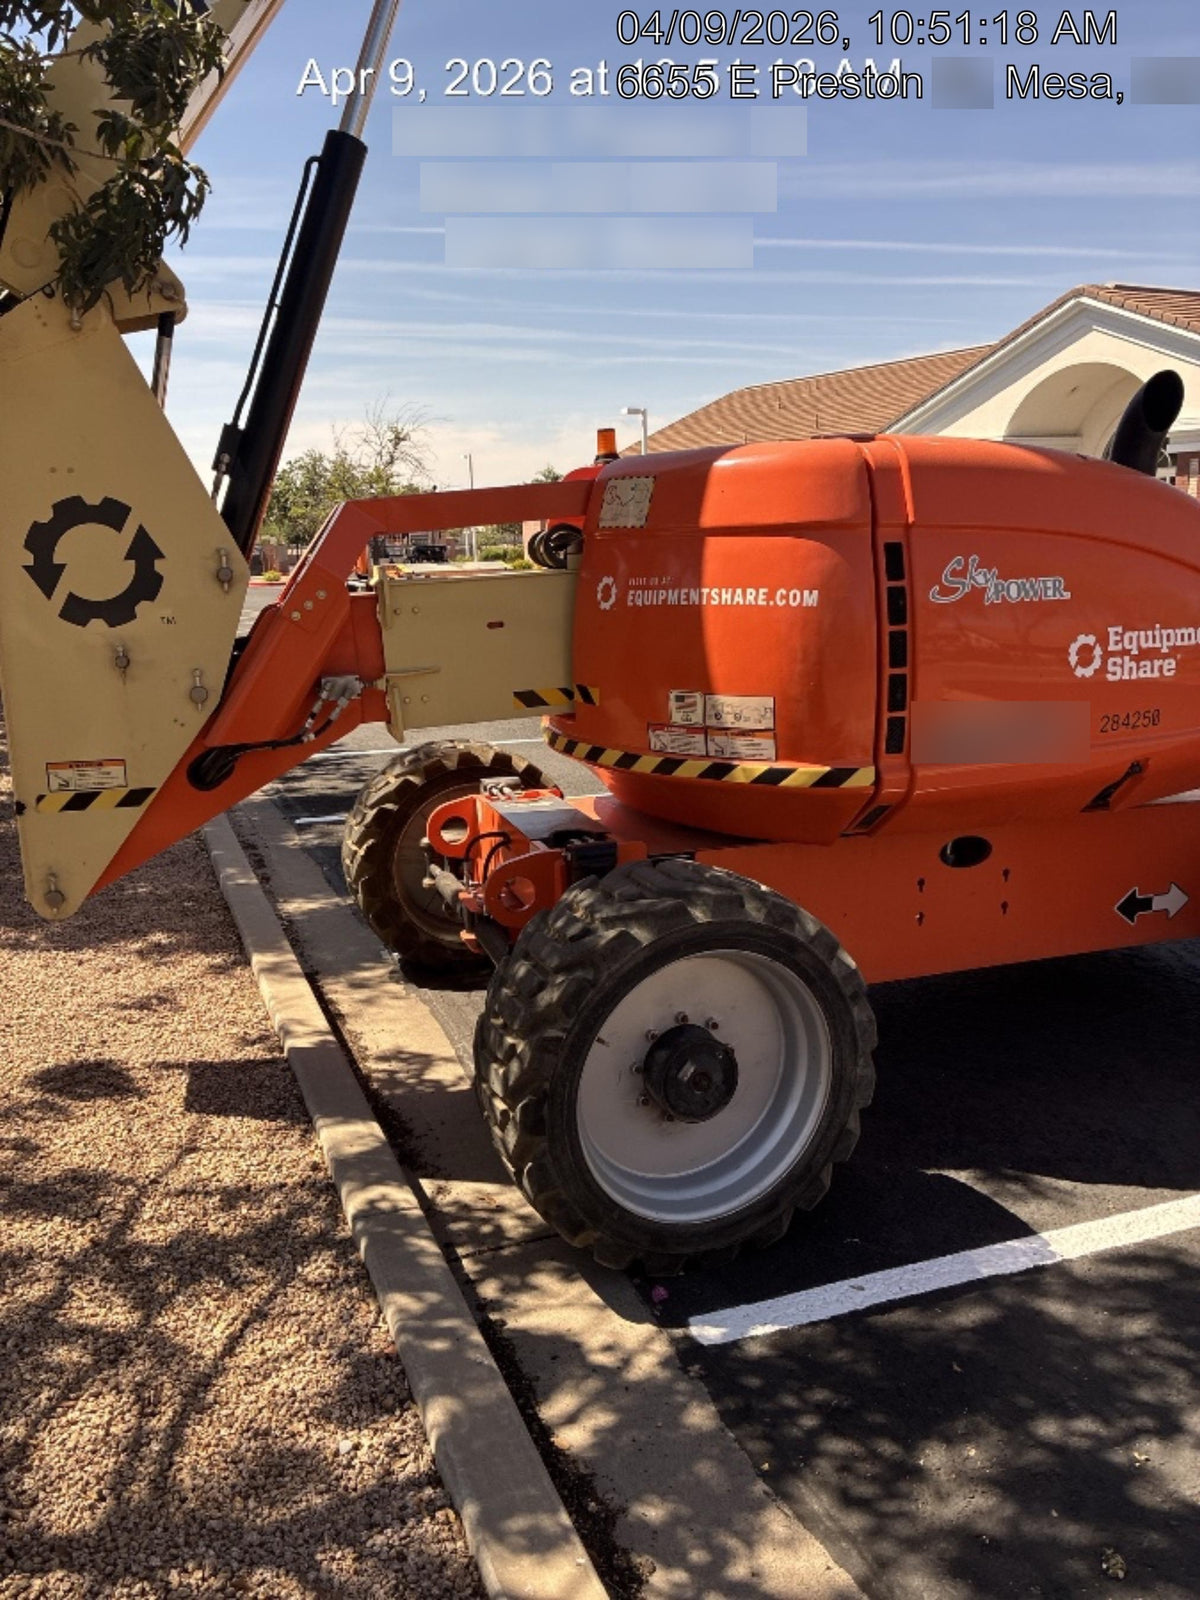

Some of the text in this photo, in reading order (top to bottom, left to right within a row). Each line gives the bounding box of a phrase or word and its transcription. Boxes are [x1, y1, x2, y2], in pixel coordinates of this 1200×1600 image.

[627, 587, 820, 607] EQUIPMENTSHARE.COM
[1107, 623, 1200, 655] Equipm
[1105, 655, 1177, 682] Share
